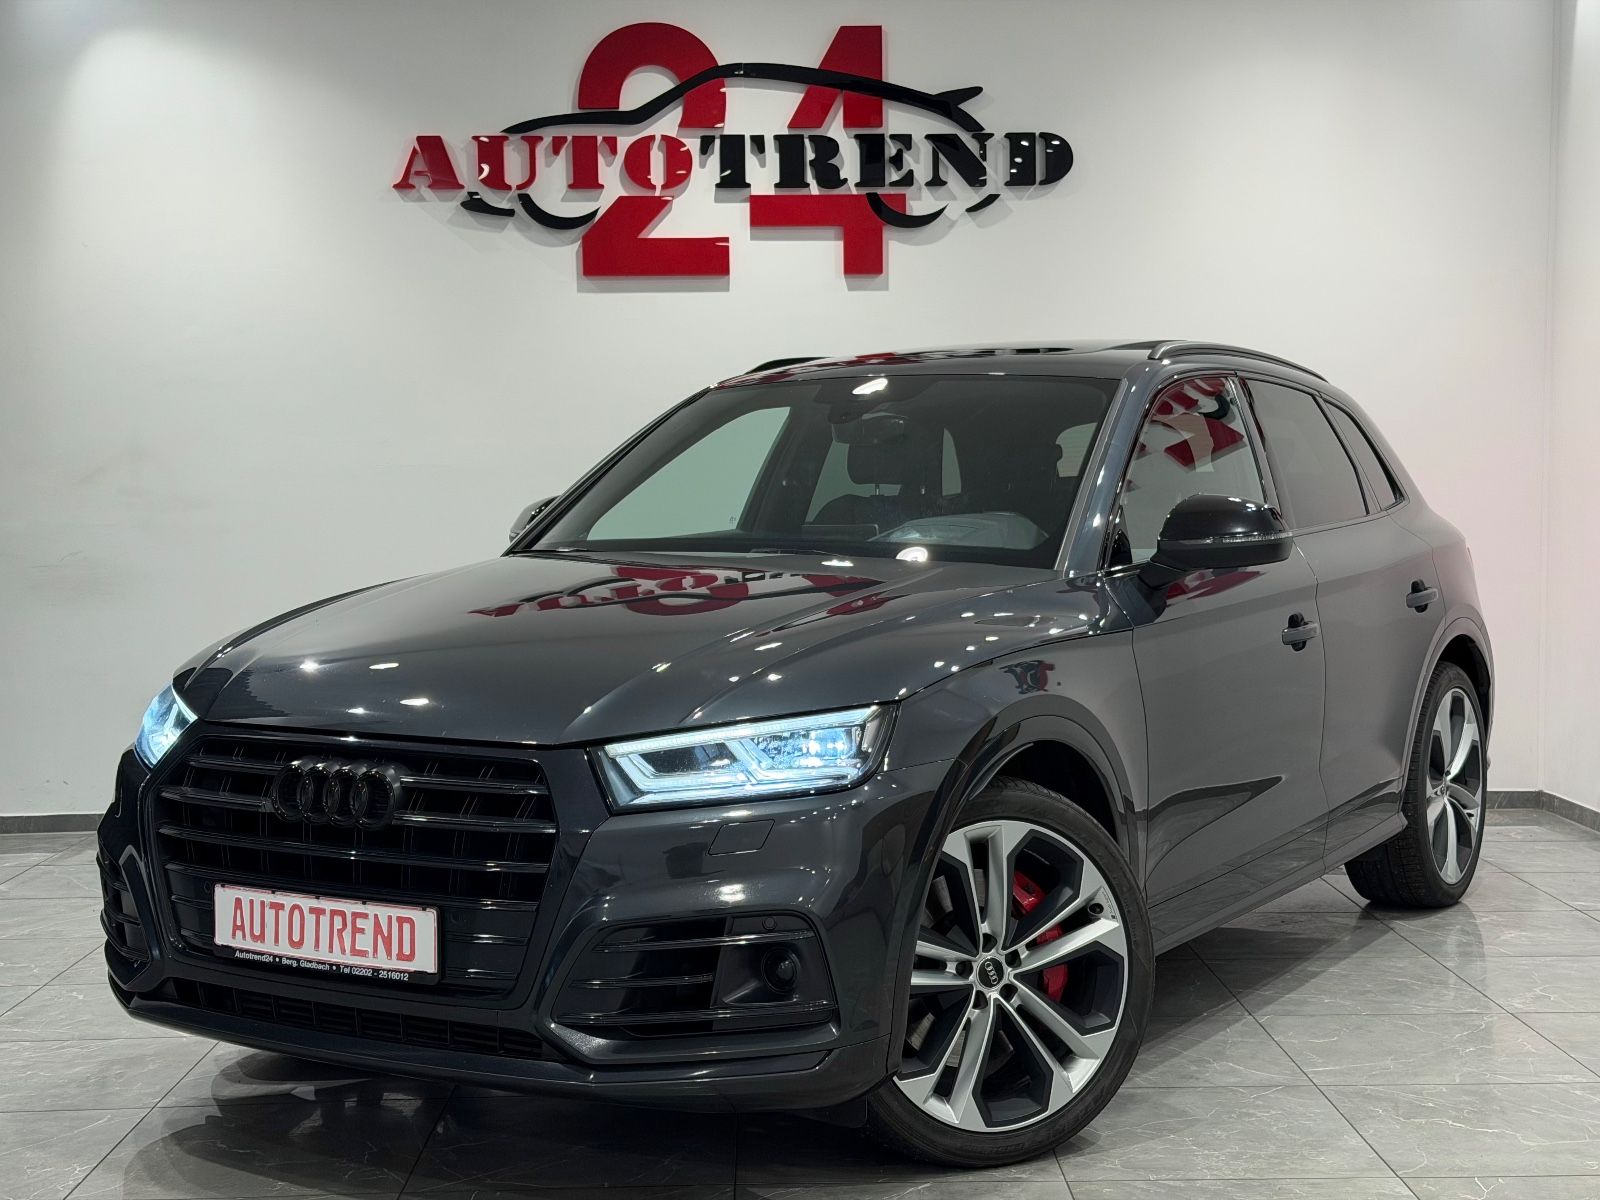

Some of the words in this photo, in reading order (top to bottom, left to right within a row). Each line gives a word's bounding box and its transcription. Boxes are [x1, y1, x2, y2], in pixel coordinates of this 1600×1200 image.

[392, 132, 1074, 192] AUTOTREND
[578, 22, 906, 276] 24
[231, 896, 416, 962] AUTOTREND
[234, 950, 274, 963] Autotrend24
[281, 957, 298, 968] Berg.
[299, 960, 330, 971] Gladbach
[340, 965, 351, 974] Tel
[351, 967, 373, 977] 02202
[378, 970, 409, 981] 2516012
